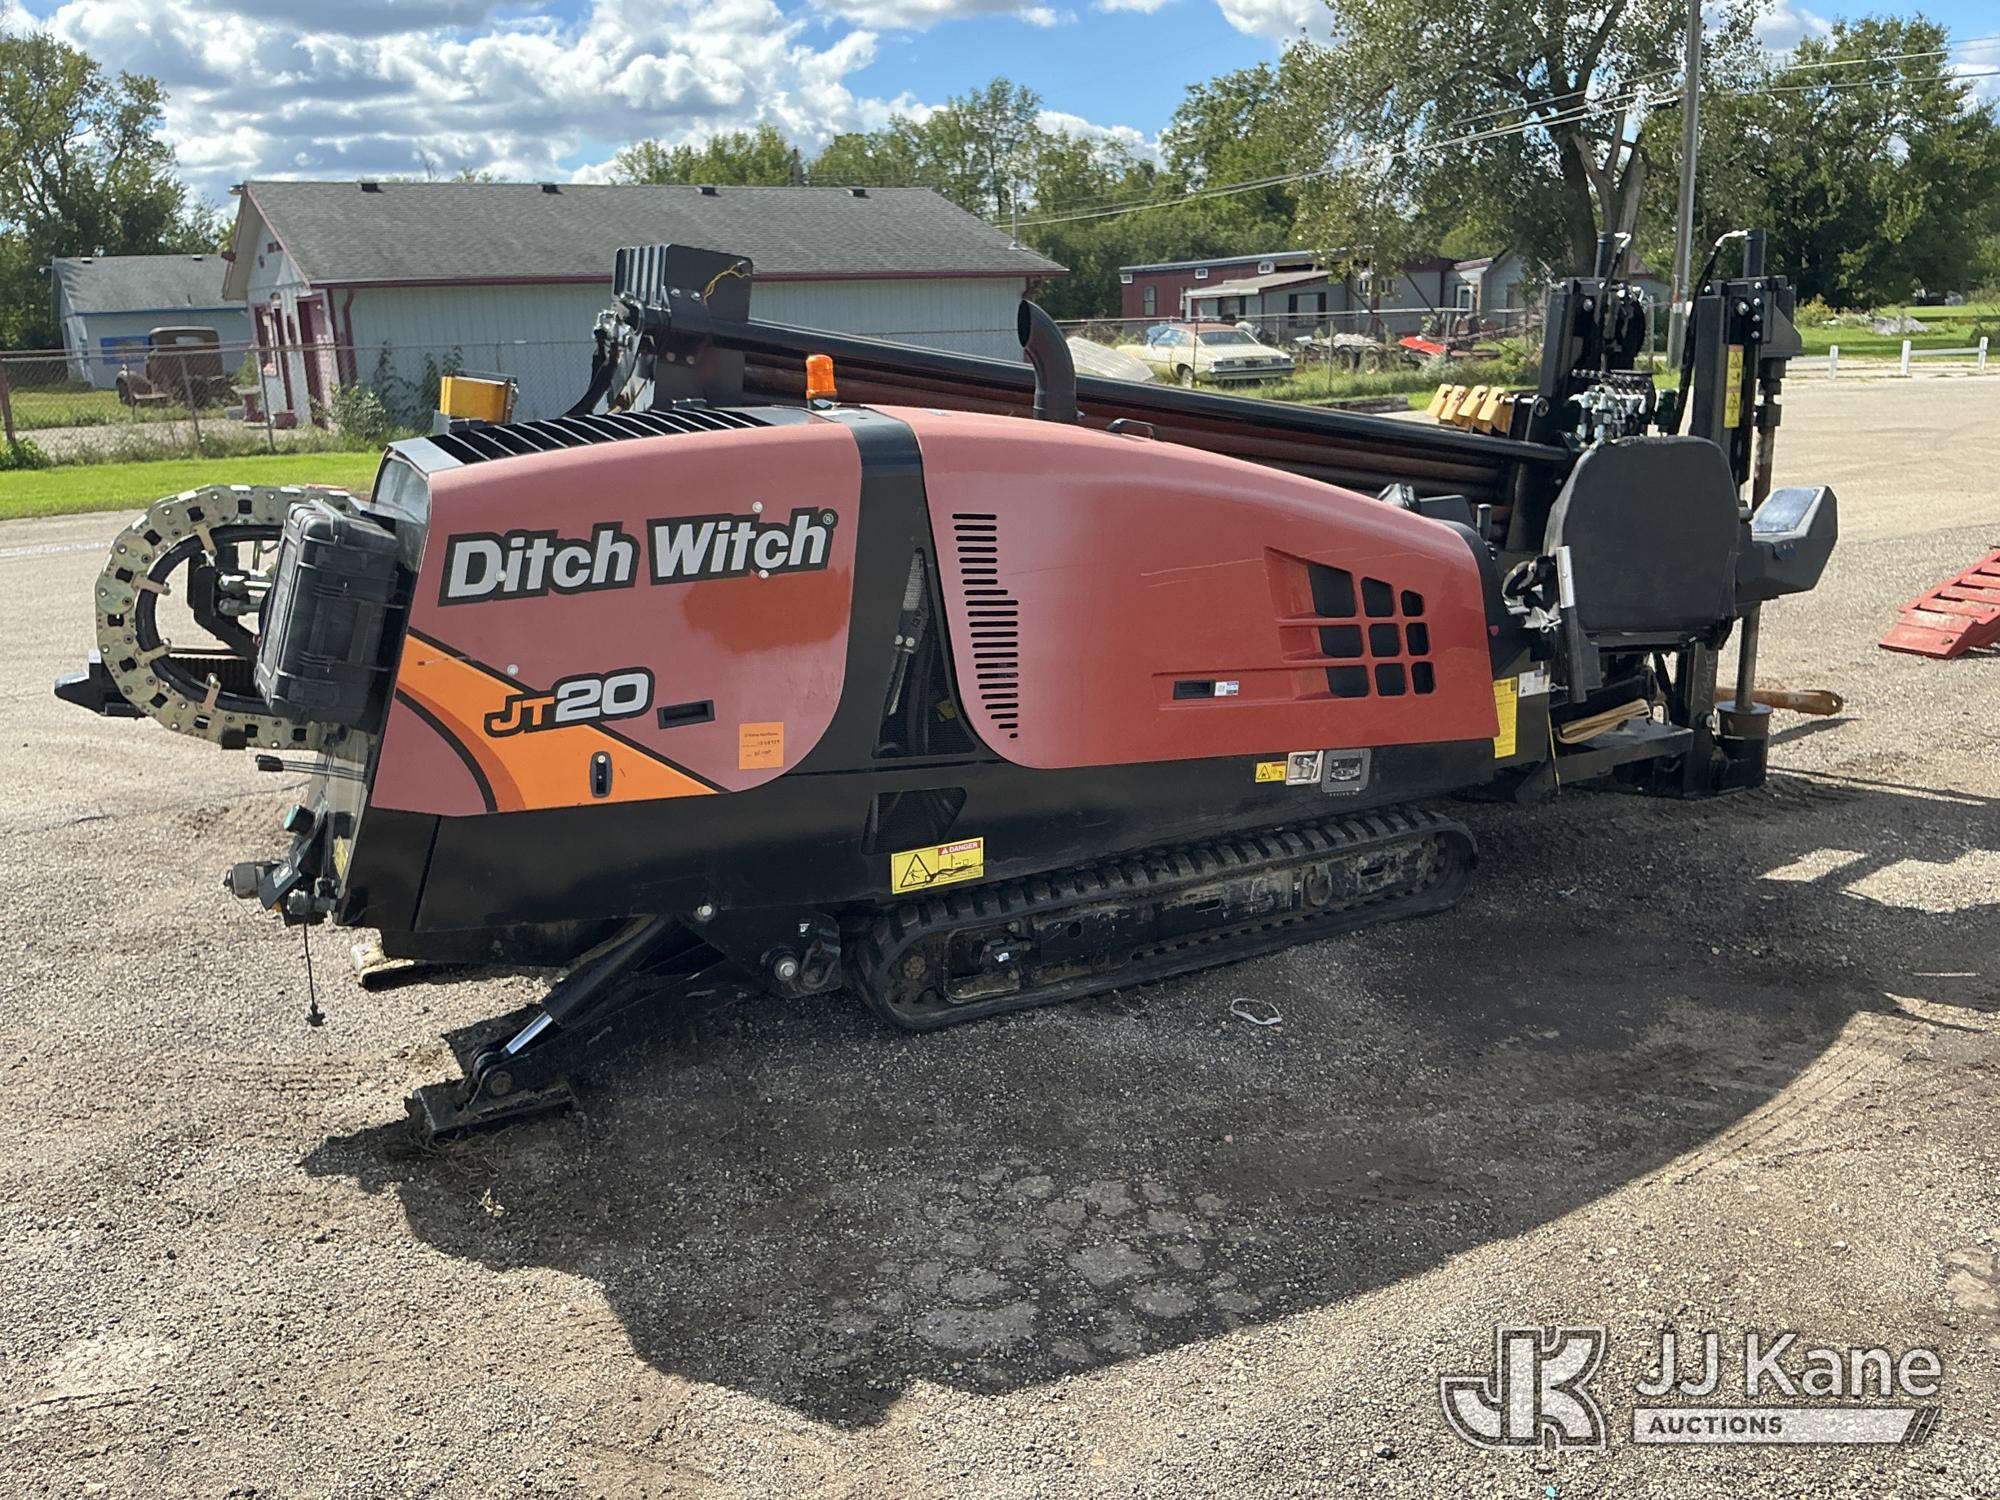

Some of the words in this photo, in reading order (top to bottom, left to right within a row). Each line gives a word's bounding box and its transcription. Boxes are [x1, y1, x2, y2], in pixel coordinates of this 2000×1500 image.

[448, 530, 633, 598] Ditch
[491, 673, 650, 732] JT20
[949, 841, 979, 853] DANGER
